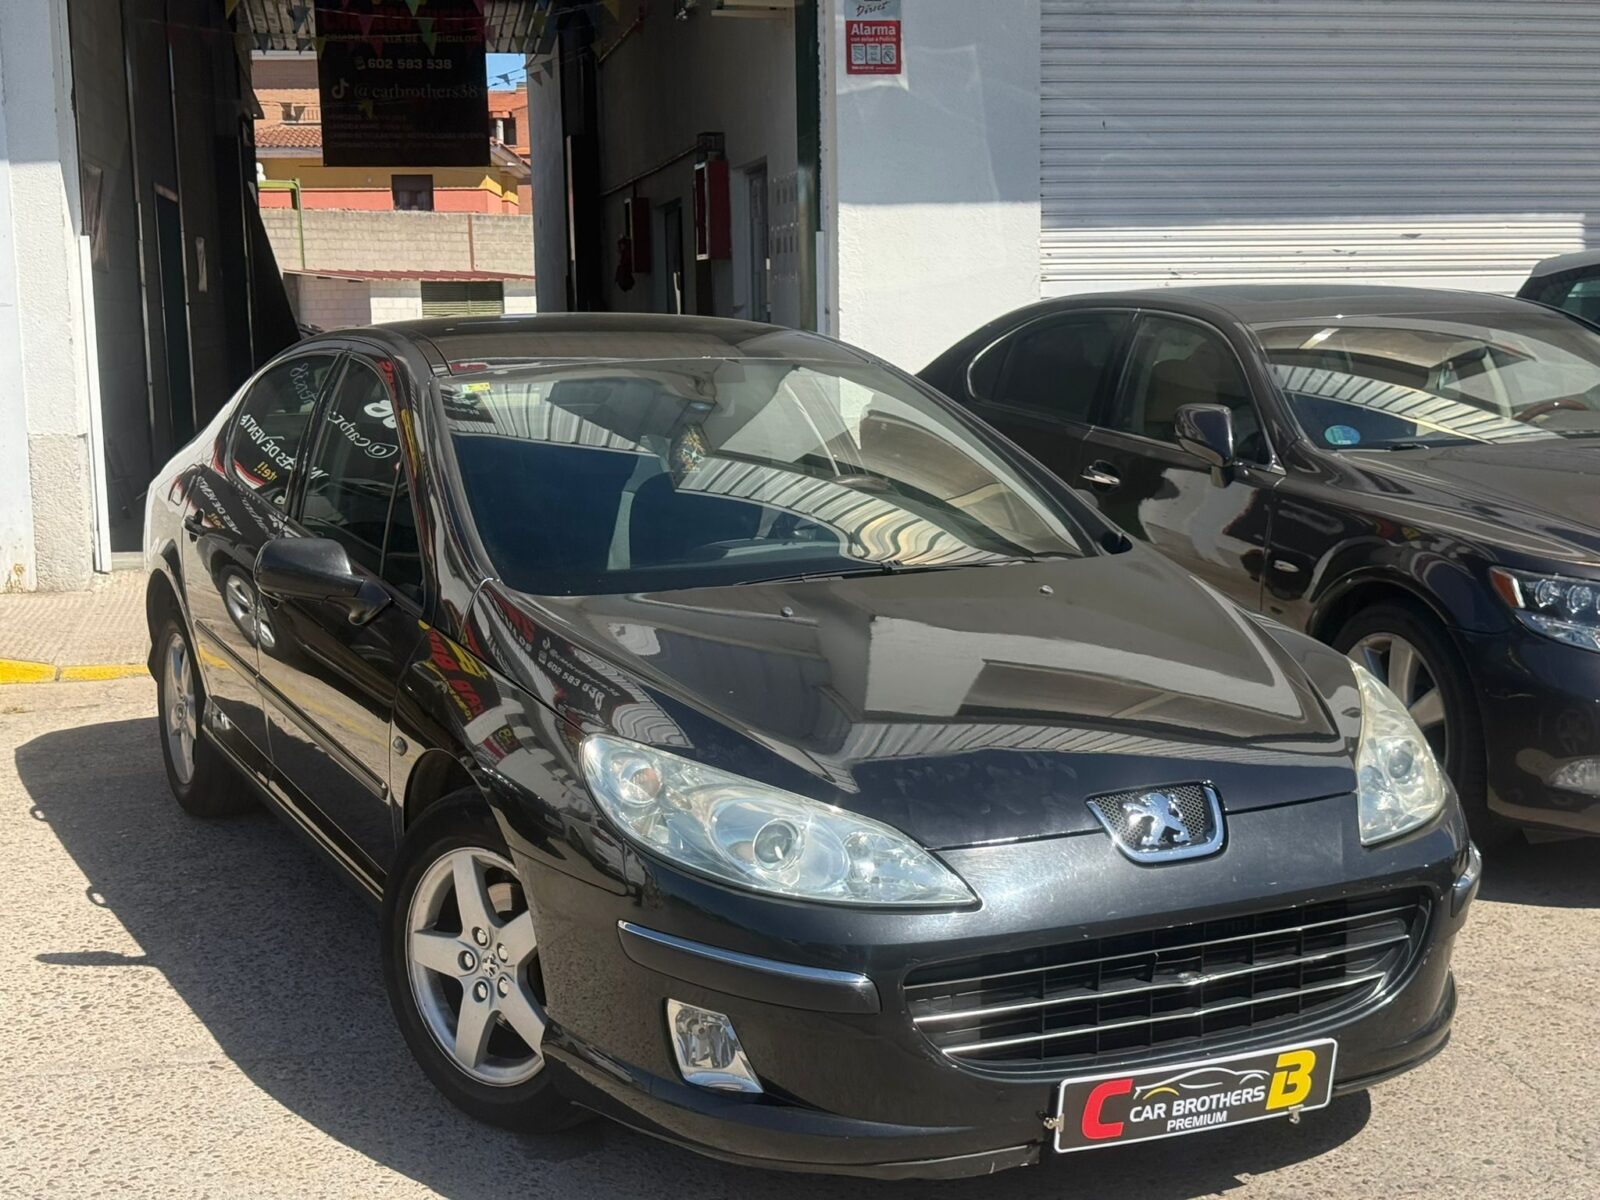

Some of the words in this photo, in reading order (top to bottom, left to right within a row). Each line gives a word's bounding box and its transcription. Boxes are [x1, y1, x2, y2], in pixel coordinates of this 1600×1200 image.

[851, 22, 896, 36] Alarma
[368, 58, 393, 70] 602
[397, 58, 423, 70] 583
[427, 58, 452, 70] 538
[1082, 1078, 1134, 1140] C
[1129, 1103, 1166, 1123] CAR
[1172, 1086, 1266, 1117] BROTHERS
[1265, 1049, 1316, 1111] B
[1166, 1110, 1228, 1133] PREMIUM
